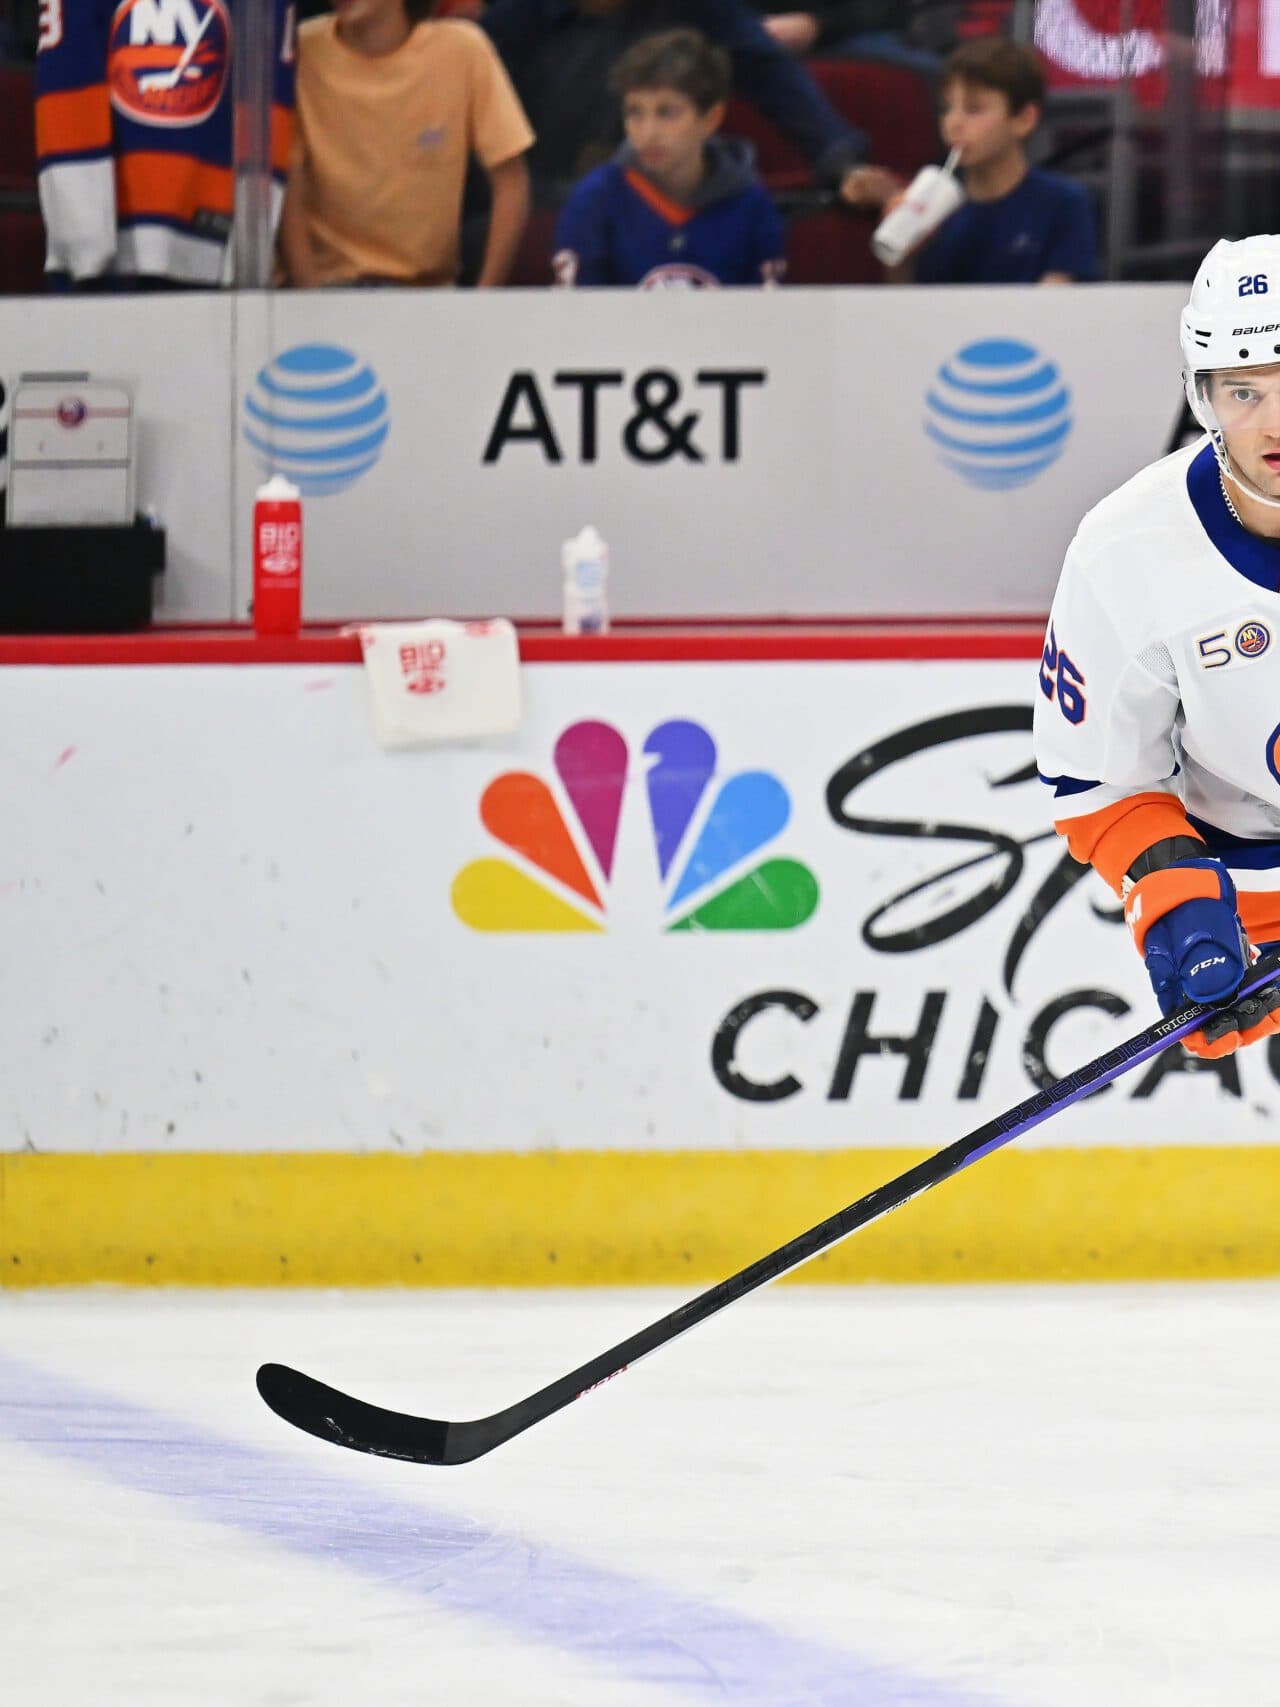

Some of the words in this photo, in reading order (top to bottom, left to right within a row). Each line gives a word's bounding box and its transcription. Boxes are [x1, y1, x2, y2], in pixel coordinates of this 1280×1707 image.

[1238, 273, 1268, 297] 26
[482, 367, 768, 465] AT&T
[1039, 618, 1086, 726] 26
[1190, 956, 1226, 977] CCM
